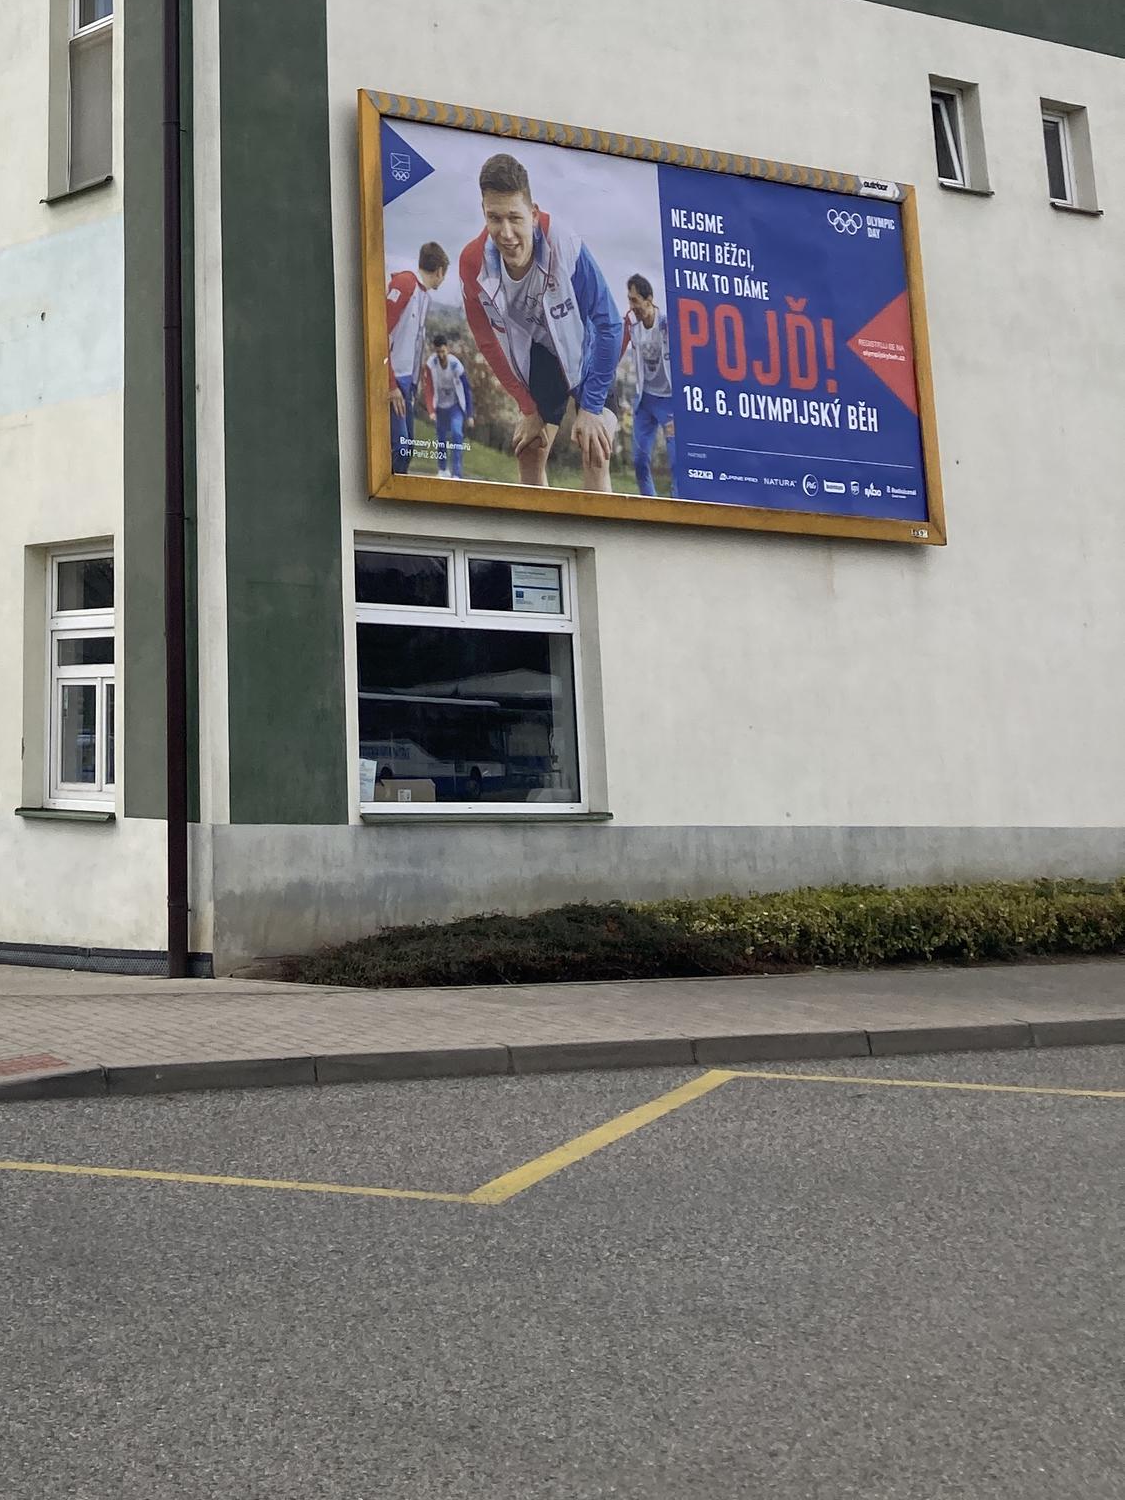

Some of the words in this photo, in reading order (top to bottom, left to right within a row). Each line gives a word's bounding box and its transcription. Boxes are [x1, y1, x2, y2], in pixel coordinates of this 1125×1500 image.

[671, 208, 724, 234] NEJSME
[866, 216, 895, 230] OLYMPIC
[867, 227, 880, 239] DAY
[673, 238, 710, 262] PROFI
[715, 242, 755, 272] BĚŽCI,
[675, 268, 680, 288] I
[683, 270, 710, 292] TAK
[712, 274, 730, 295] TO
[734, 275, 770, 301] DÁME
[678, 295, 838, 394] POJĎ!
[683, 385, 710, 414] 18.
[715, 389, 733, 417] 6.
[738, 392, 842, 429] OLYMPIJSKÝ
[847, 401, 880, 433] BĚH
[399, 436, 431, 449] Bronzový
[432, 440, 445, 449] tým
[400, 448, 412, 457] OH
[430, 450, 447, 460] 2024
